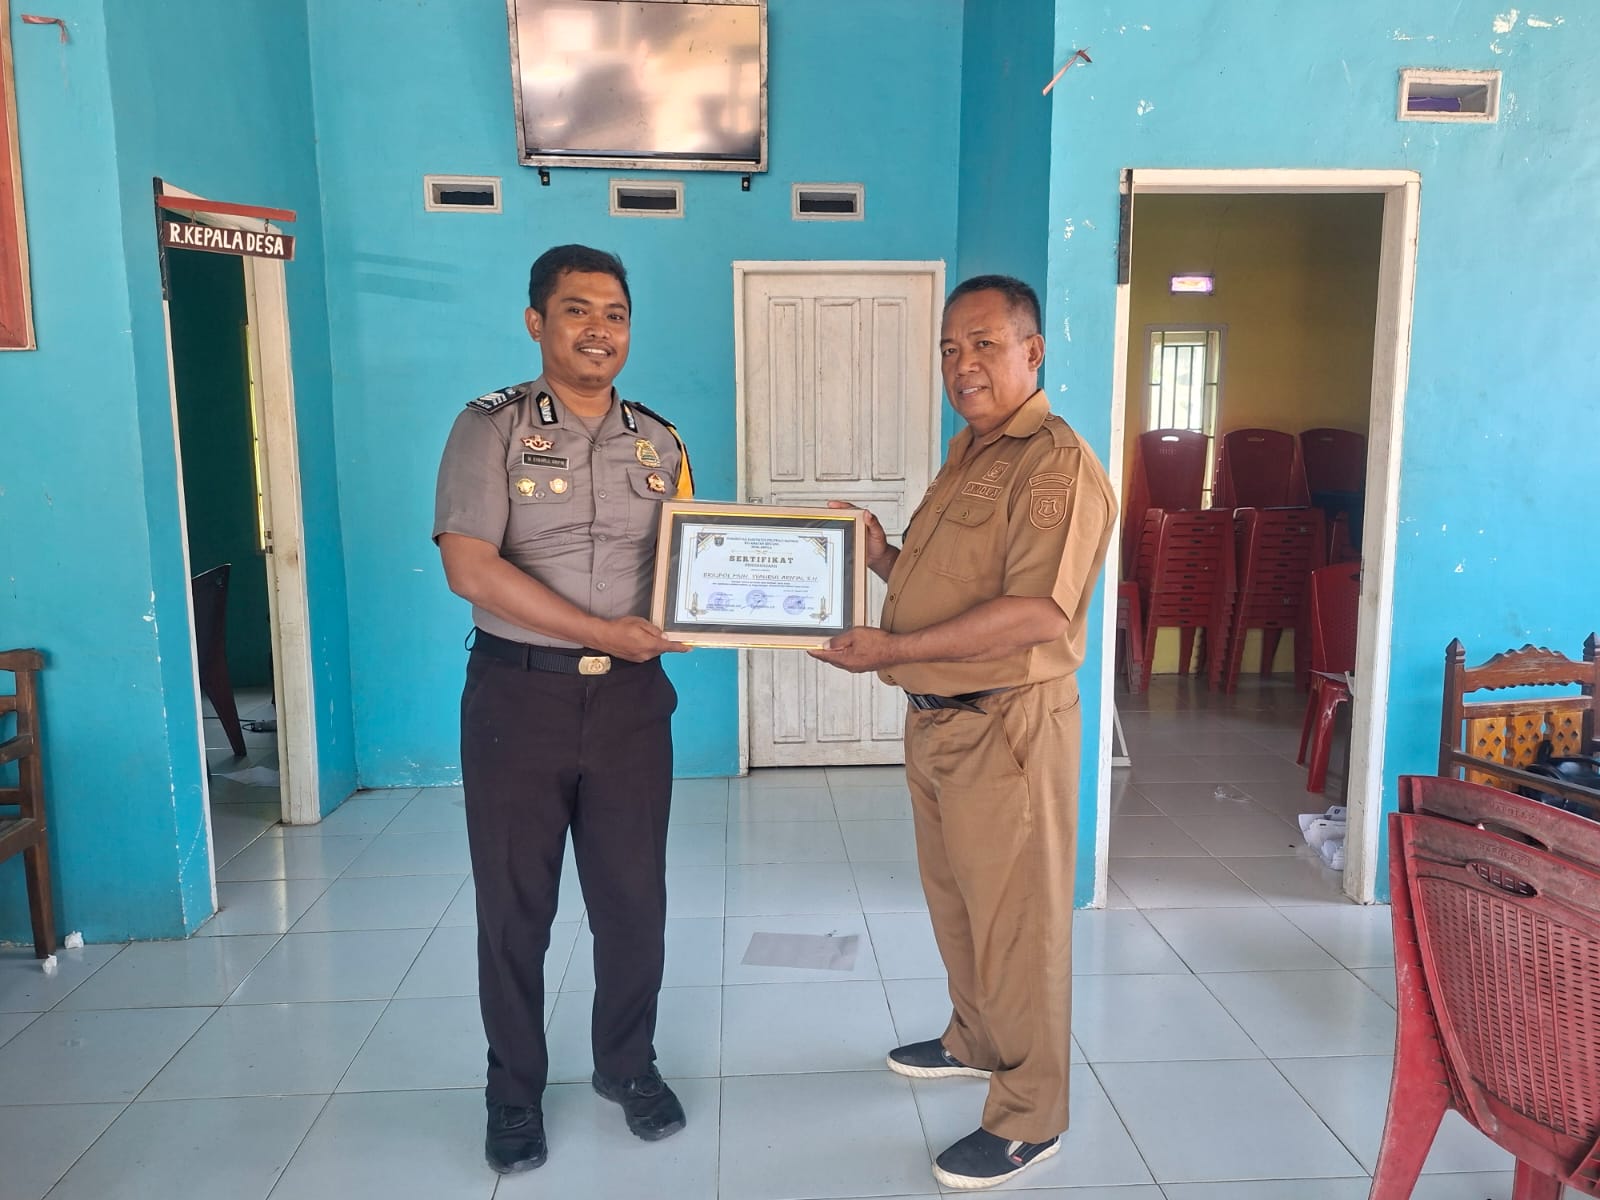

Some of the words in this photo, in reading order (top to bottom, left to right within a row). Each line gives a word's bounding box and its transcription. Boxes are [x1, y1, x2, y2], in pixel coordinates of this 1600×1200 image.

[169, 223, 243, 250] R.KEPALA
[247, 232, 284, 255] DESA
[729, 555, 794, 563] SERTIFIKAT
